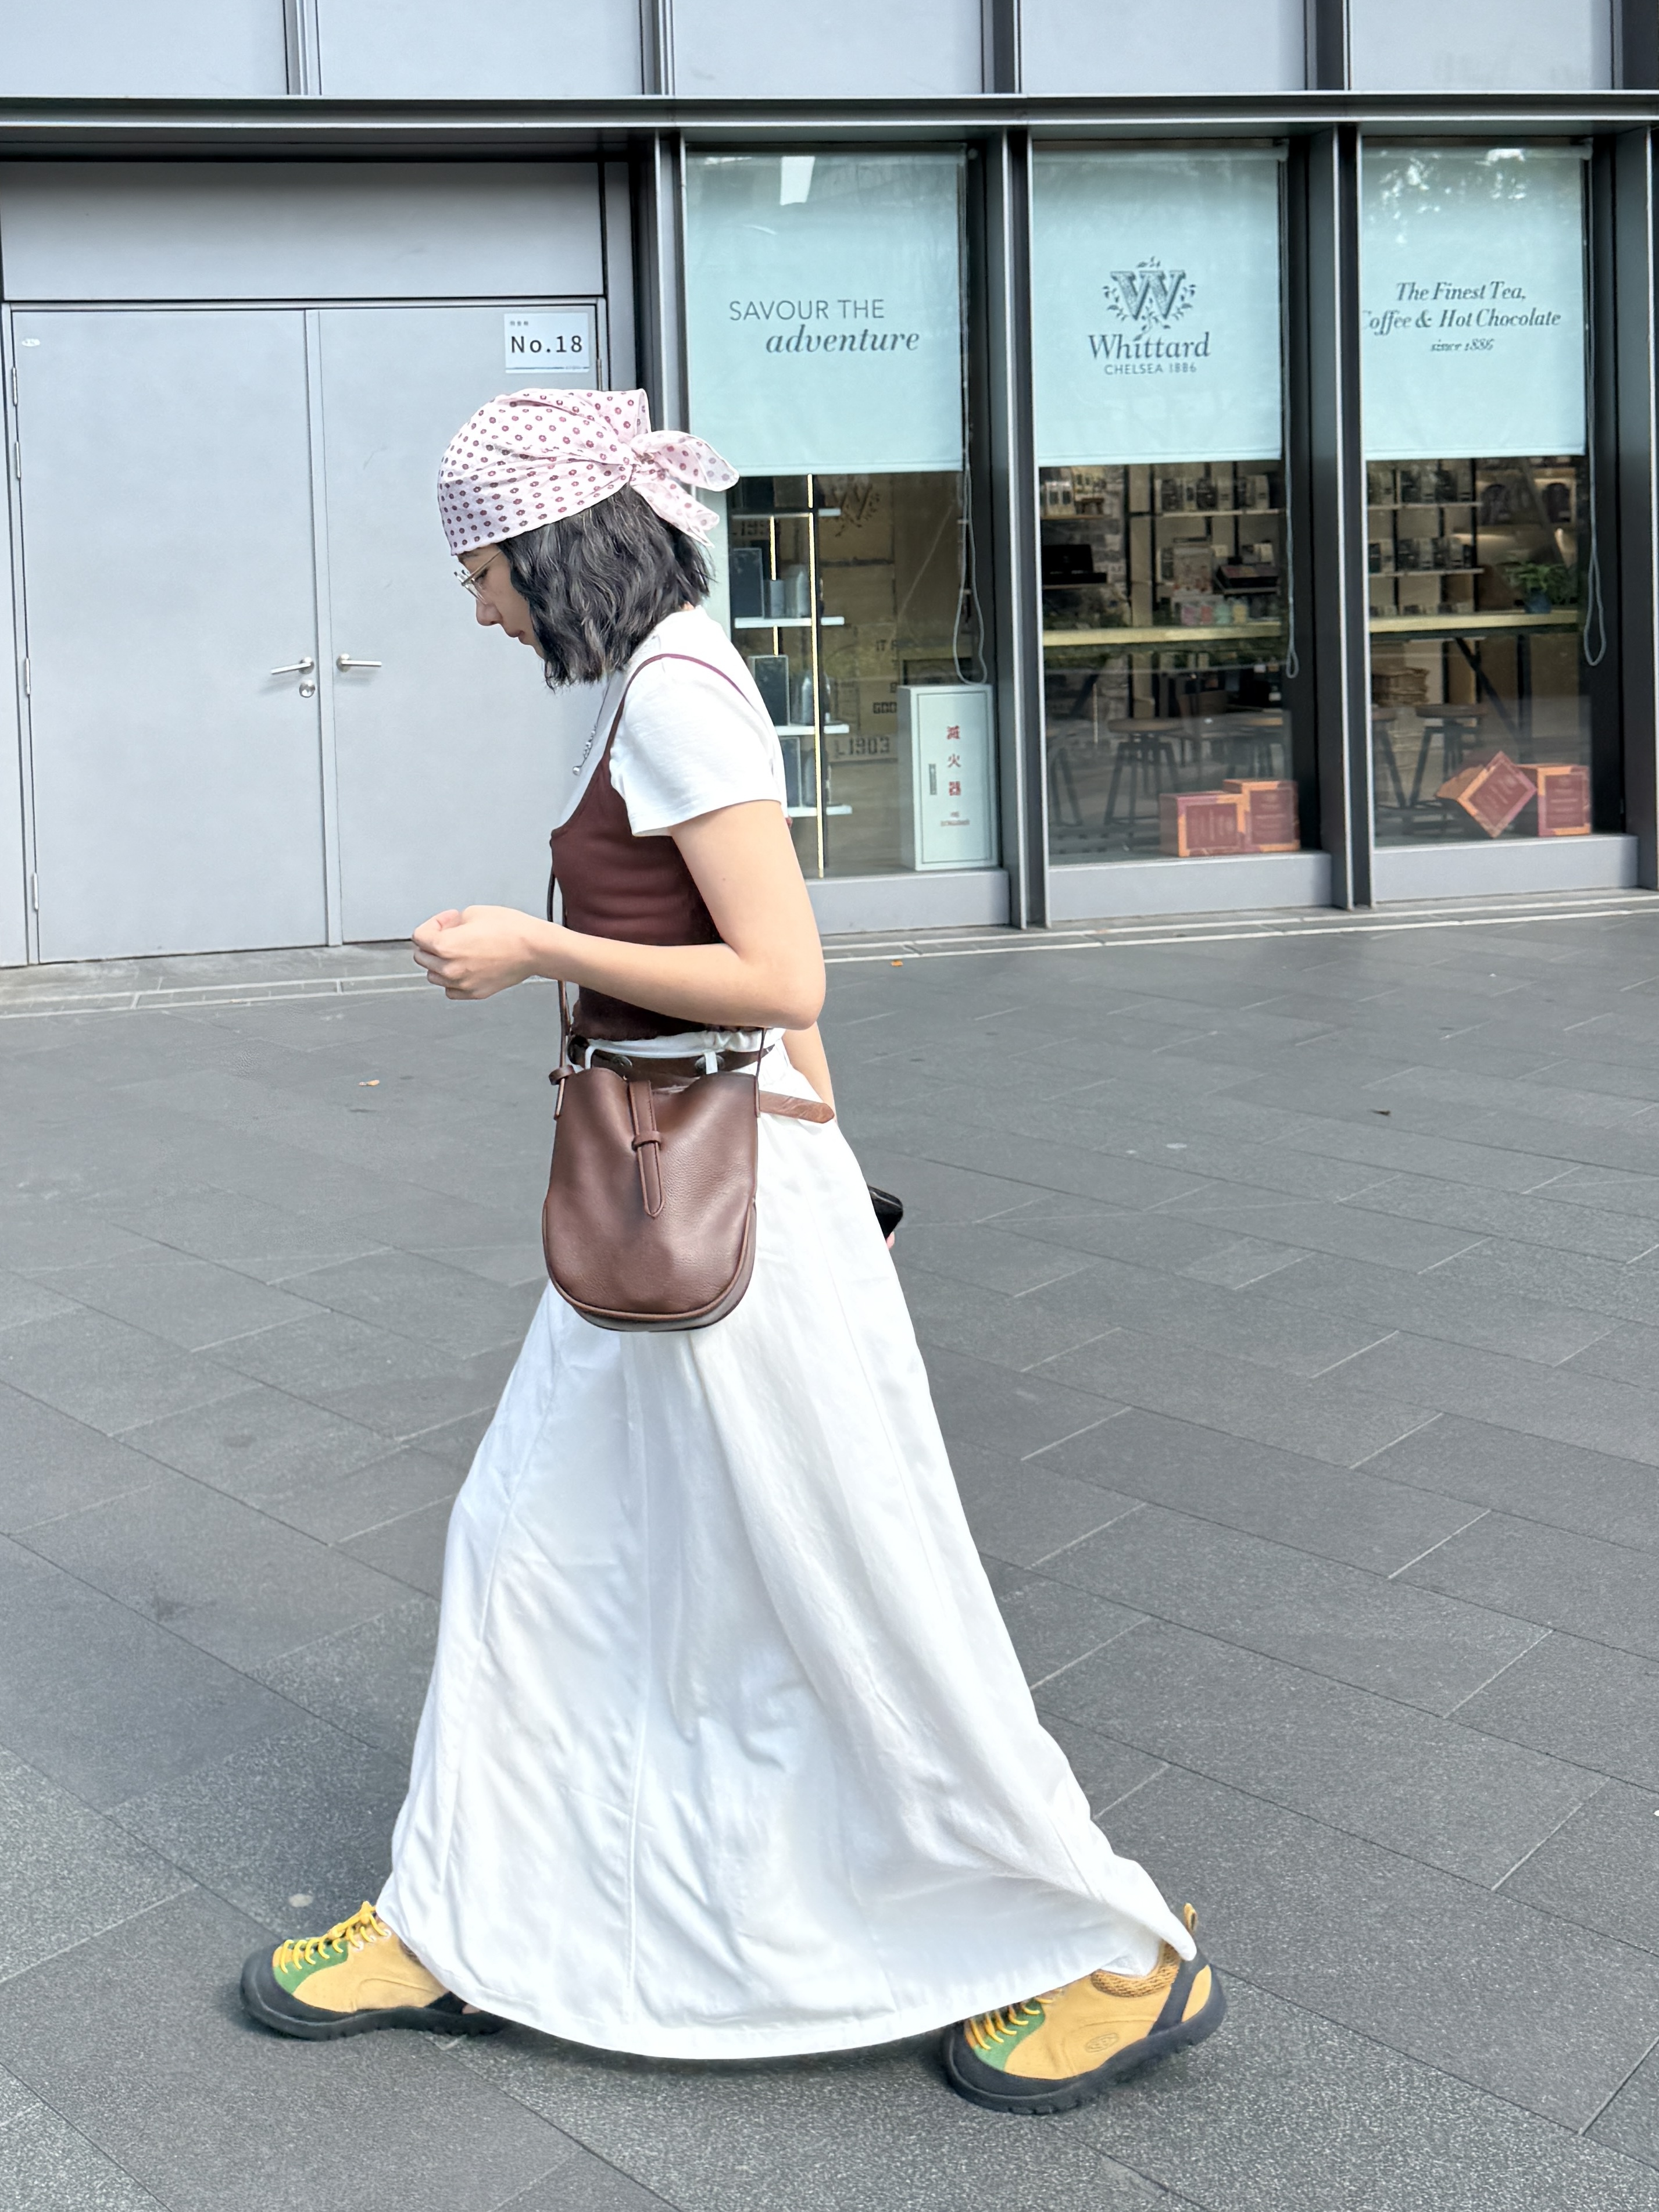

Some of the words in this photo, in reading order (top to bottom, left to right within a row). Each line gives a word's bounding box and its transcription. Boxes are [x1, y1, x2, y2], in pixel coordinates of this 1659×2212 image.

[1396, 282, 1429, 301] The
[1431, 281, 1486, 301] Finest
[1490, 281, 1526, 301] Tea,
[729, 300, 829, 320] SAVOUR
[837, 299, 885, 319] THE
[1415, 309, 1432, 328] &
[1439, 309, 1473, 327] Hot
[1476, 308, 1561, 327] Chocolate
[511, 335, 582, 353] No.18
[766, 323, 920, 353] adventure
[1088, 331, 1211, 359] Whittard
[1431, 339, 1463, 351] since
[1464, 338, 1495, 351] 1886
[1104, 363, 1164, 375] CHELSEA
[1169, 362, 1197, 373] 1886
